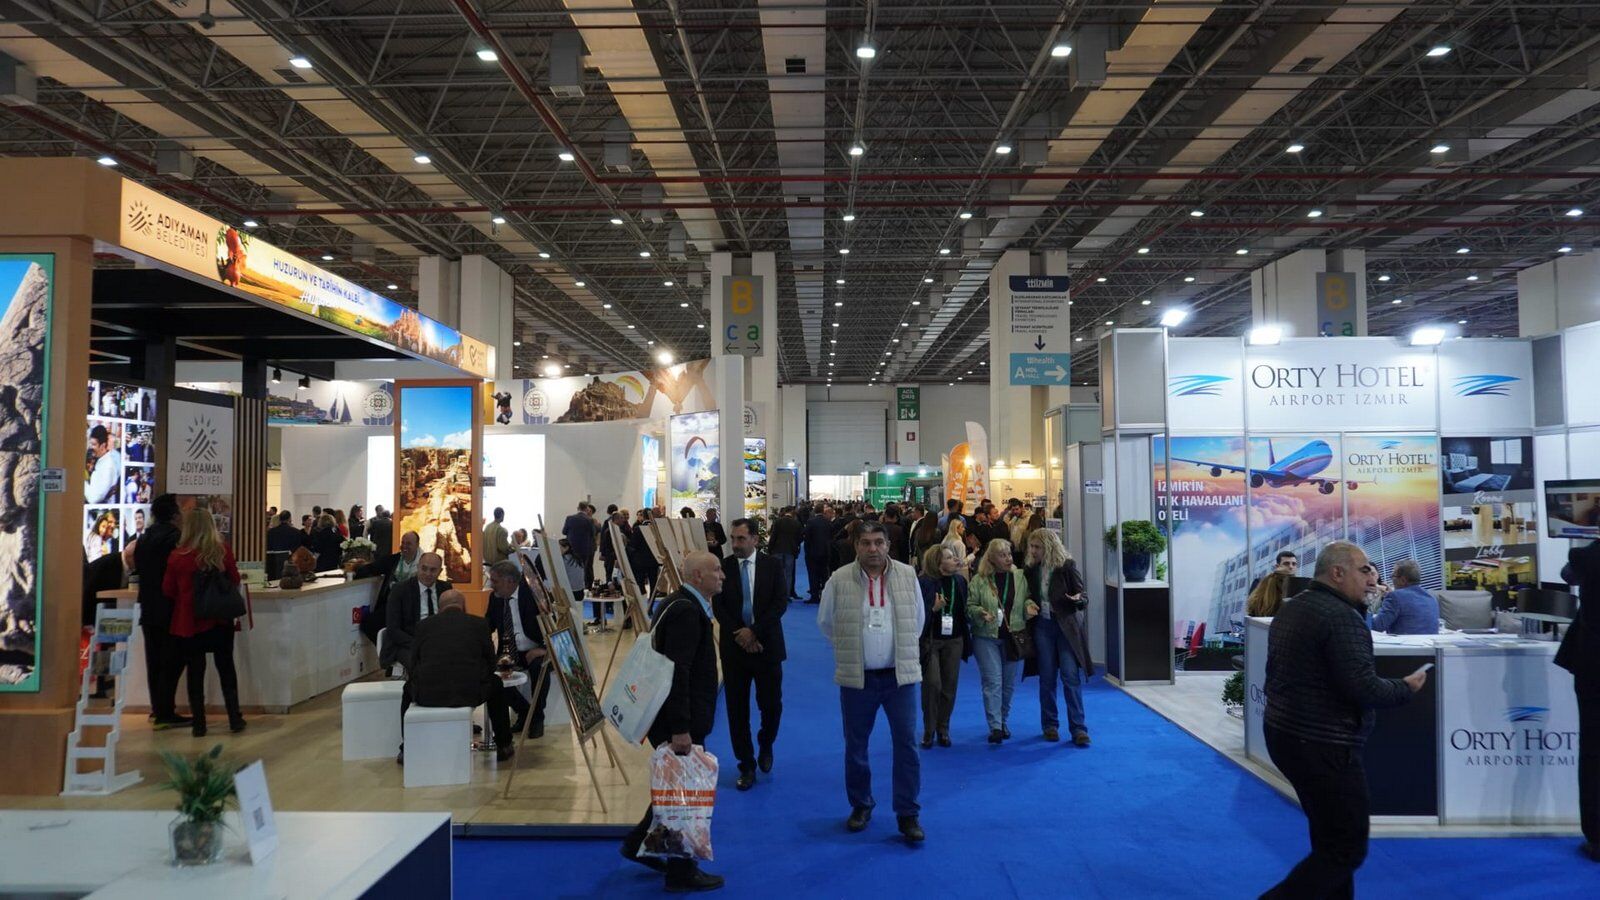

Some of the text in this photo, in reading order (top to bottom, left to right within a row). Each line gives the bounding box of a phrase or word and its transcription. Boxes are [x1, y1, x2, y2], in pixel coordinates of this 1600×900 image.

[157, 213, 208, 244] ADIYAMAN
[273, 258, 308, 280] HUZURUN
[309, 274, 318, 286] VE
[731, 281, 754, 315] B
[1325, 277, 1348, 310] B
[1014, 366, 1025, 379] A
[1252, 363, 1423, 389] ORTY HOTEL
[1269, 393, 1408, 406] AIRPORT IZMIR
[1348, 452, 1430, 466] ORTY HOTEL
[180, 462, 223, 474] ADIYAMAN
[1182, 495, 1244, 506] HAVAALANI
[1158, 508, 1189, 521] OELİ
[1475, 545, 1504, 559] Lobby
[1450, 728, 1580, 751] ORTY HOT
[1466, 755, 1576, 766] AIRPORT IZMI
